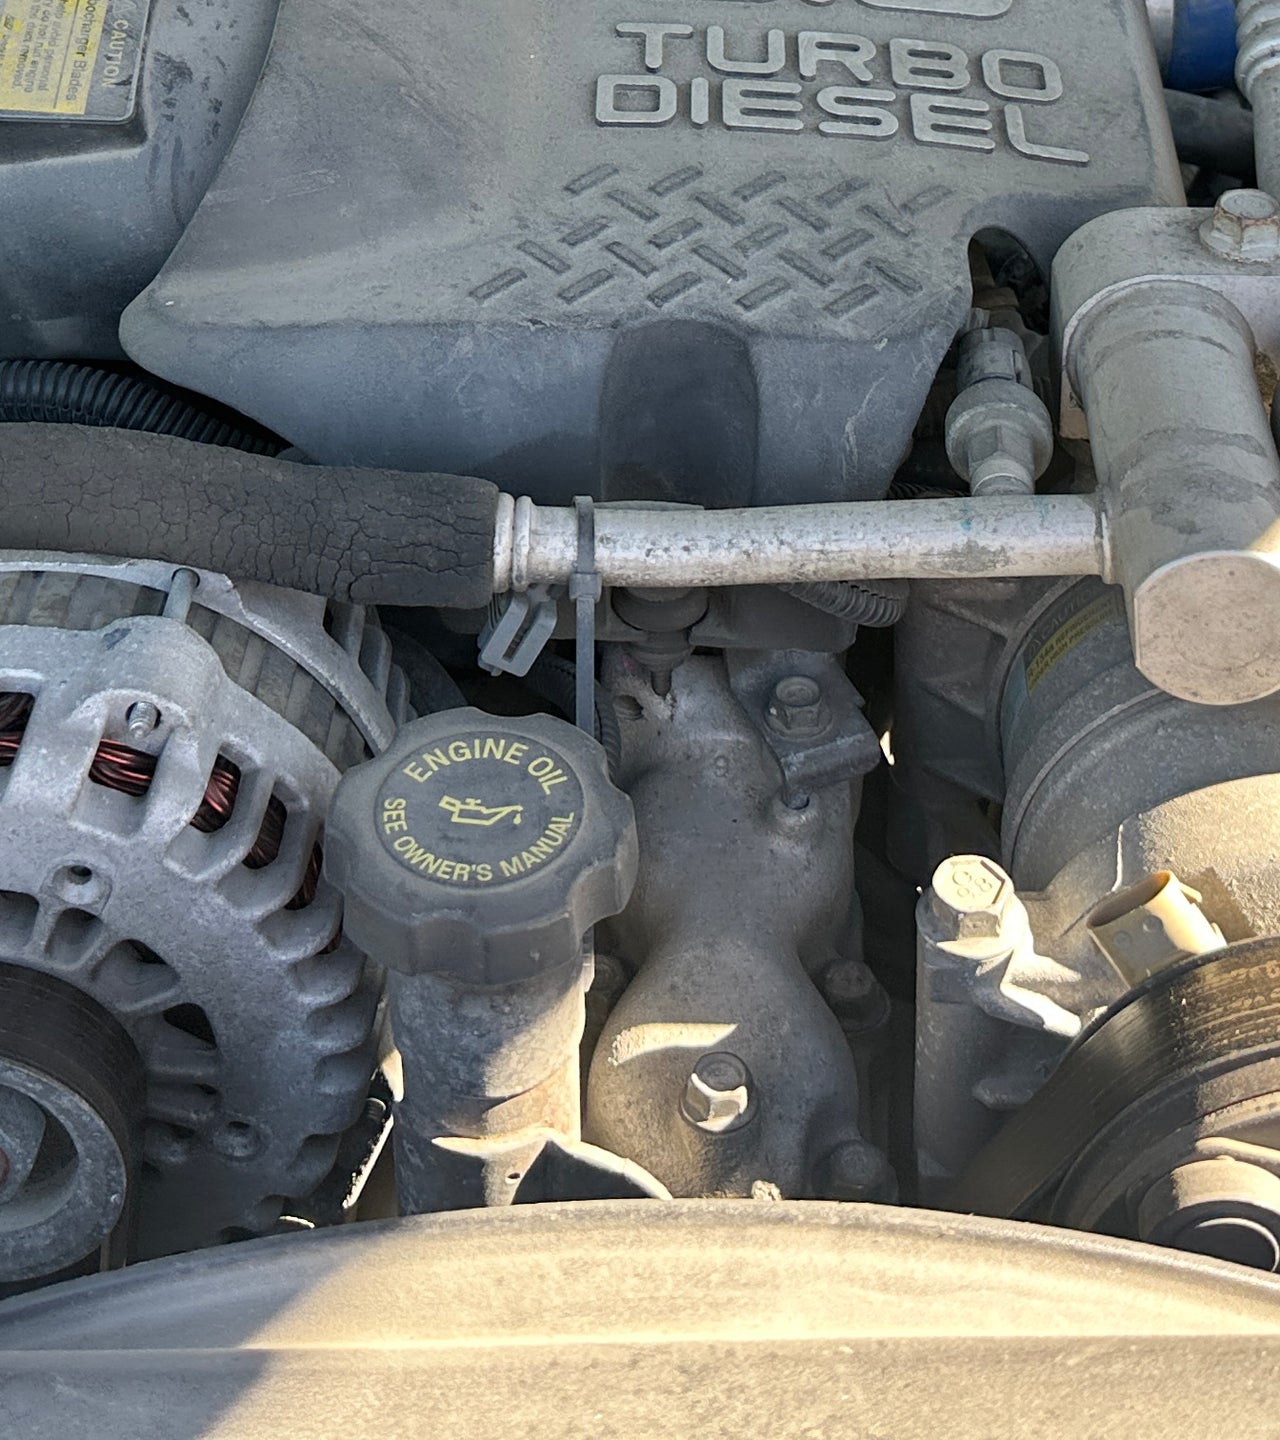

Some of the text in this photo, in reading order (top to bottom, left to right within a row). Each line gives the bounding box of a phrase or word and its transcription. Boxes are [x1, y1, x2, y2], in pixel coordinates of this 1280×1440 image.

[36, 24, 47, 39] not
[53, 0, 68, 19] help
[65, 59, 87, 101] Blades
[101, 18, 129, 88] CAUTION
[616, 22, 1063, 102] TURBO
[595, 74, 1090, 165] DIESEL
[403, 738, 568, 795] ENGINE OIL
[383, 797, 575, 882] SEE OWNER'S MANUAL
